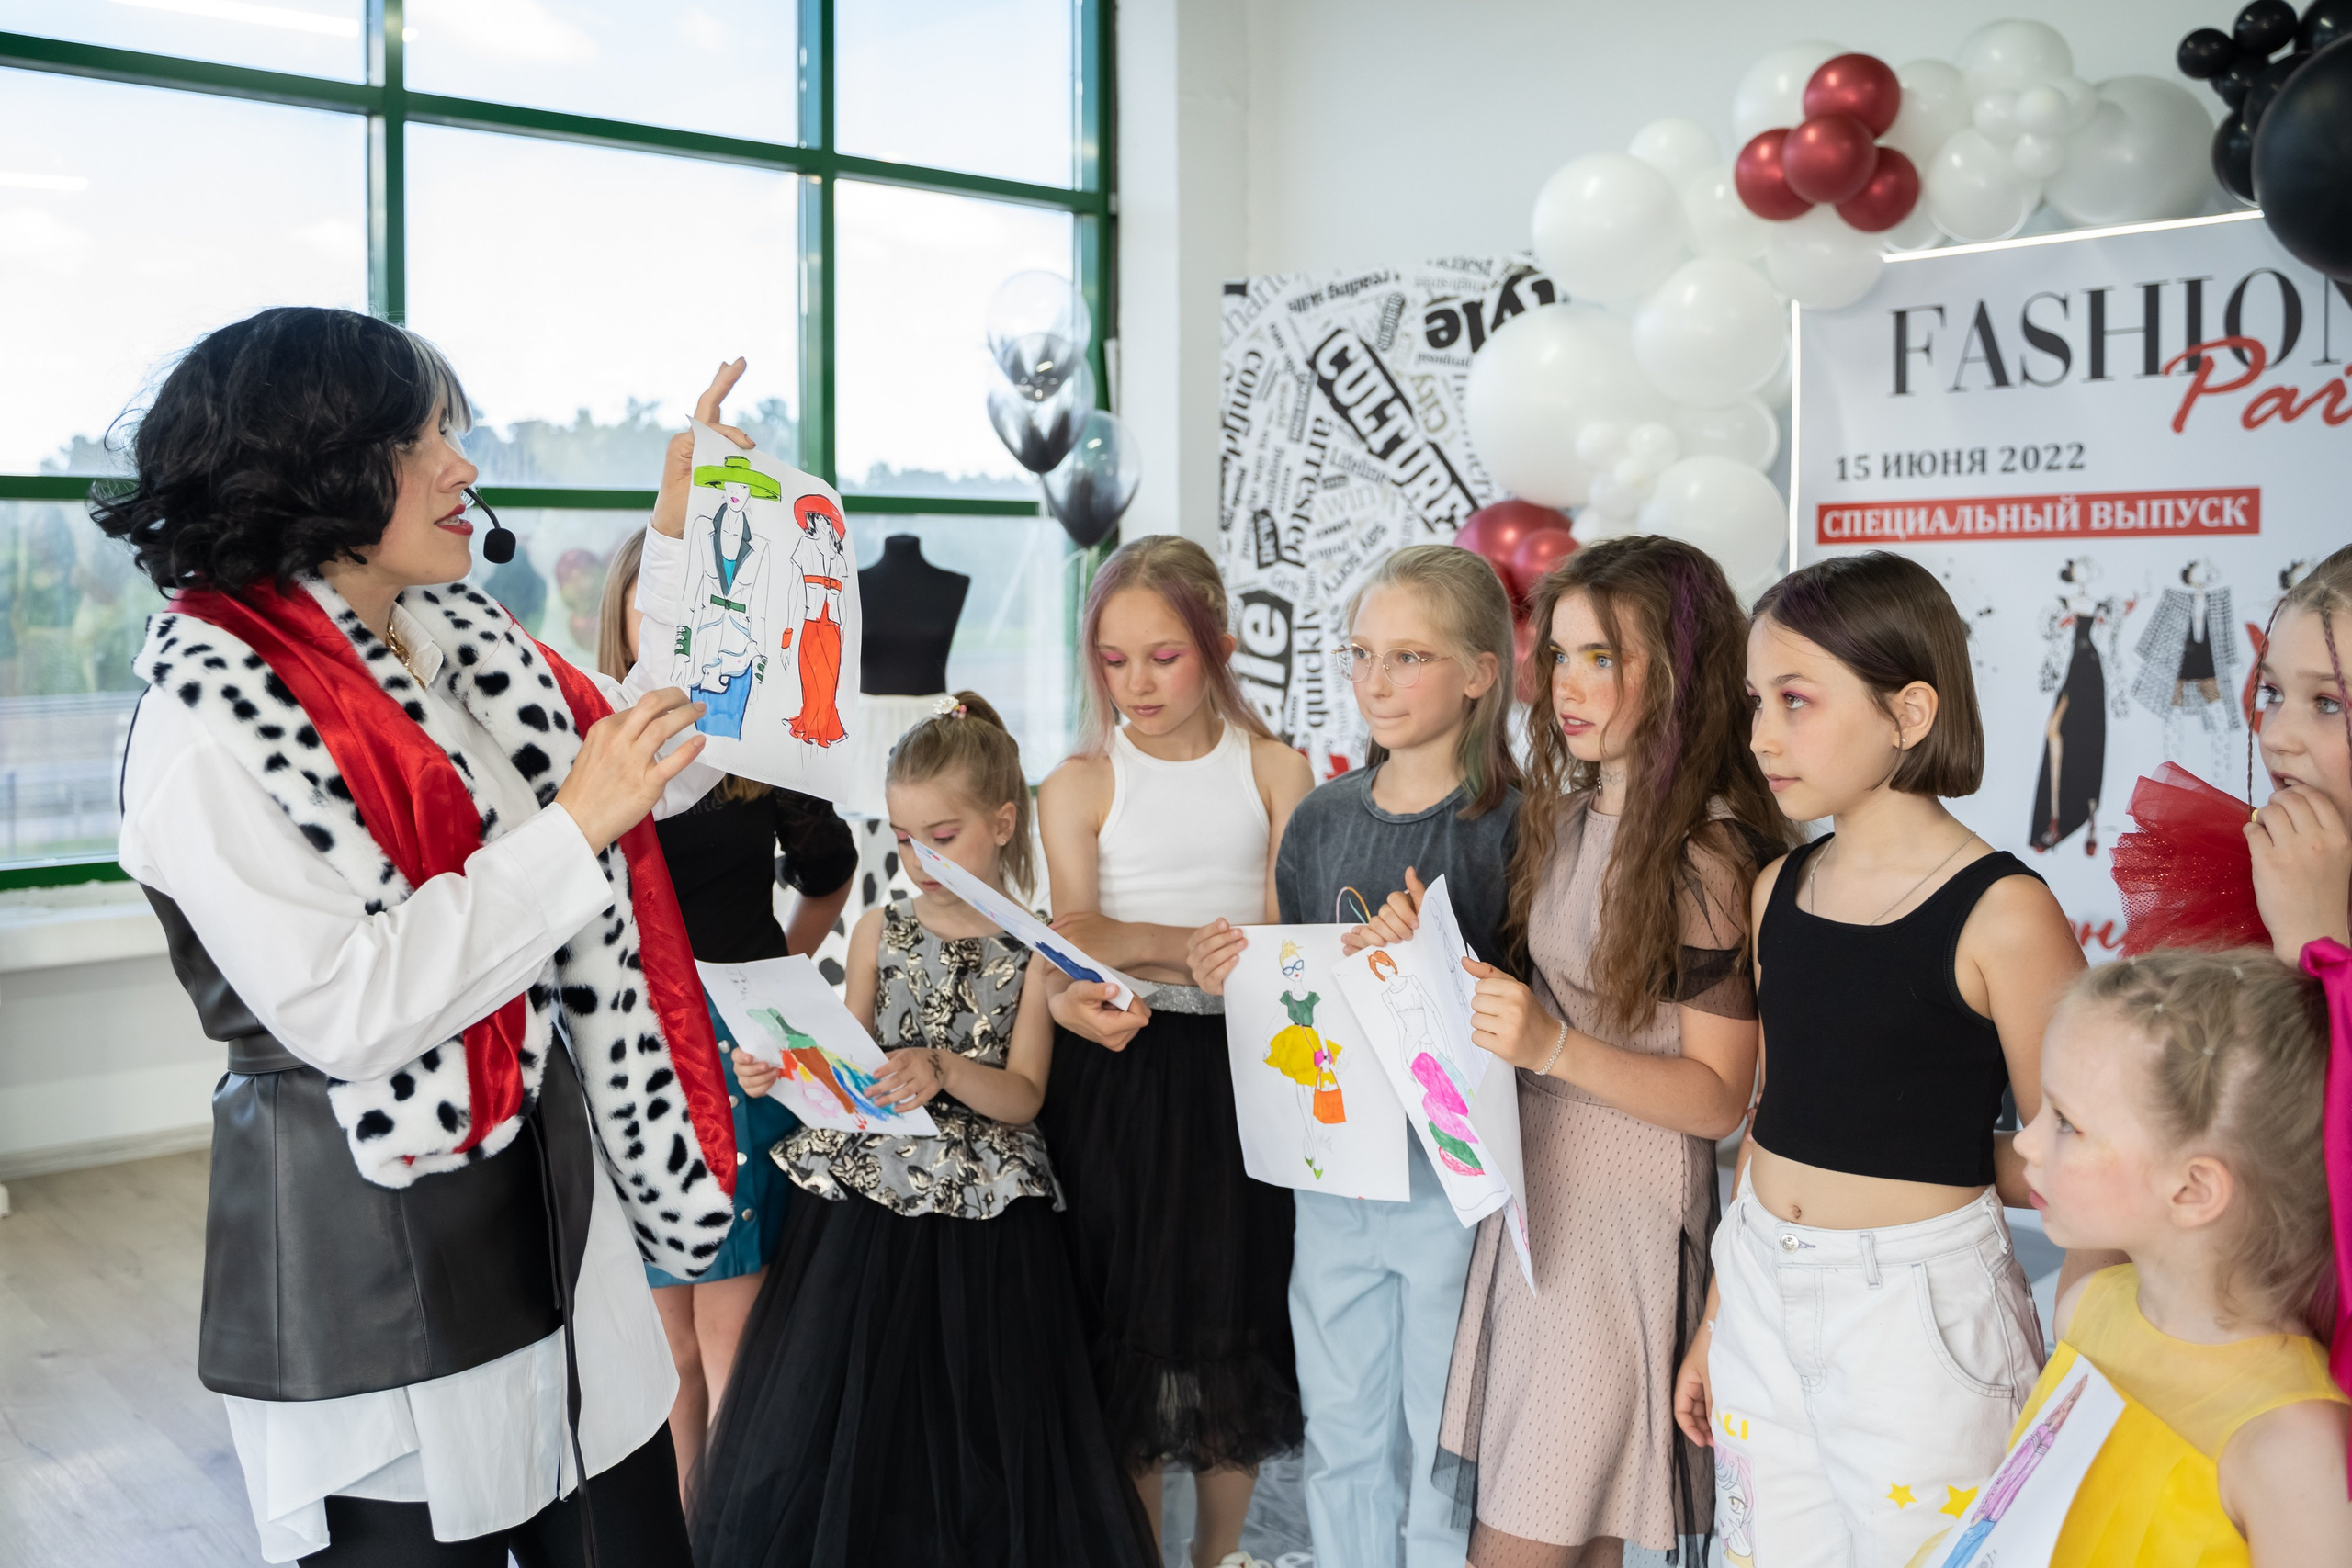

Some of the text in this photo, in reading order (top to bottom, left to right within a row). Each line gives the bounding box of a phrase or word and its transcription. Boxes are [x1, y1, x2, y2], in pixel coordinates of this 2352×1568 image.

[1316, 328, 1475, 535] CULTURE
[1836, 442, 2086, 481] 15 ИЮНЯ 2022
[1283, 416, 1331, 568] arrested
[1822, 494, 2249, 542] СПЕЦИАЛЬНЫЙ ВЫПУСК
